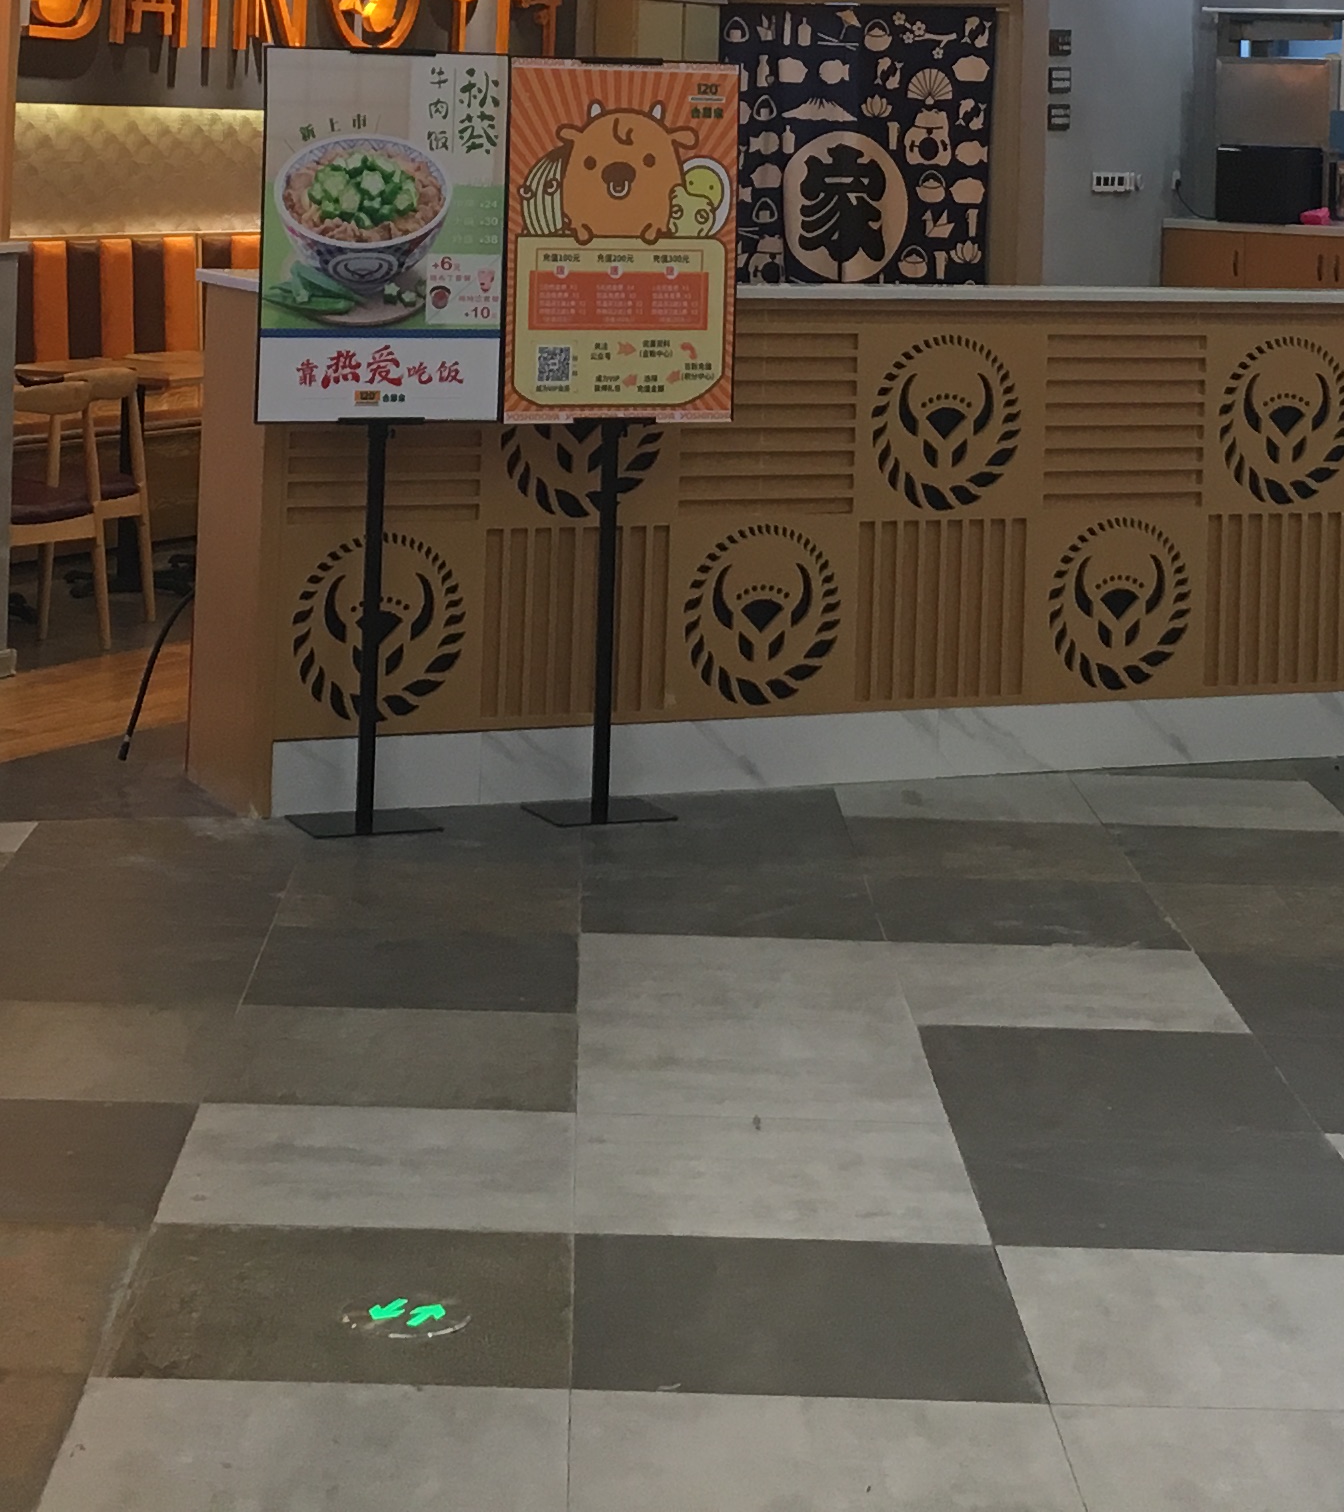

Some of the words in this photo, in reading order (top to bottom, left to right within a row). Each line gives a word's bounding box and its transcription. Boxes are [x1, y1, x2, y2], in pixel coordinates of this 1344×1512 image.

[299, 113, 368, 142] 新上市
[426, 66, 450, 152] 牛肉饭
[457, 67, 501, 155] 秋葵
[296, 344, 464, 389] 靠热爱吃饭
